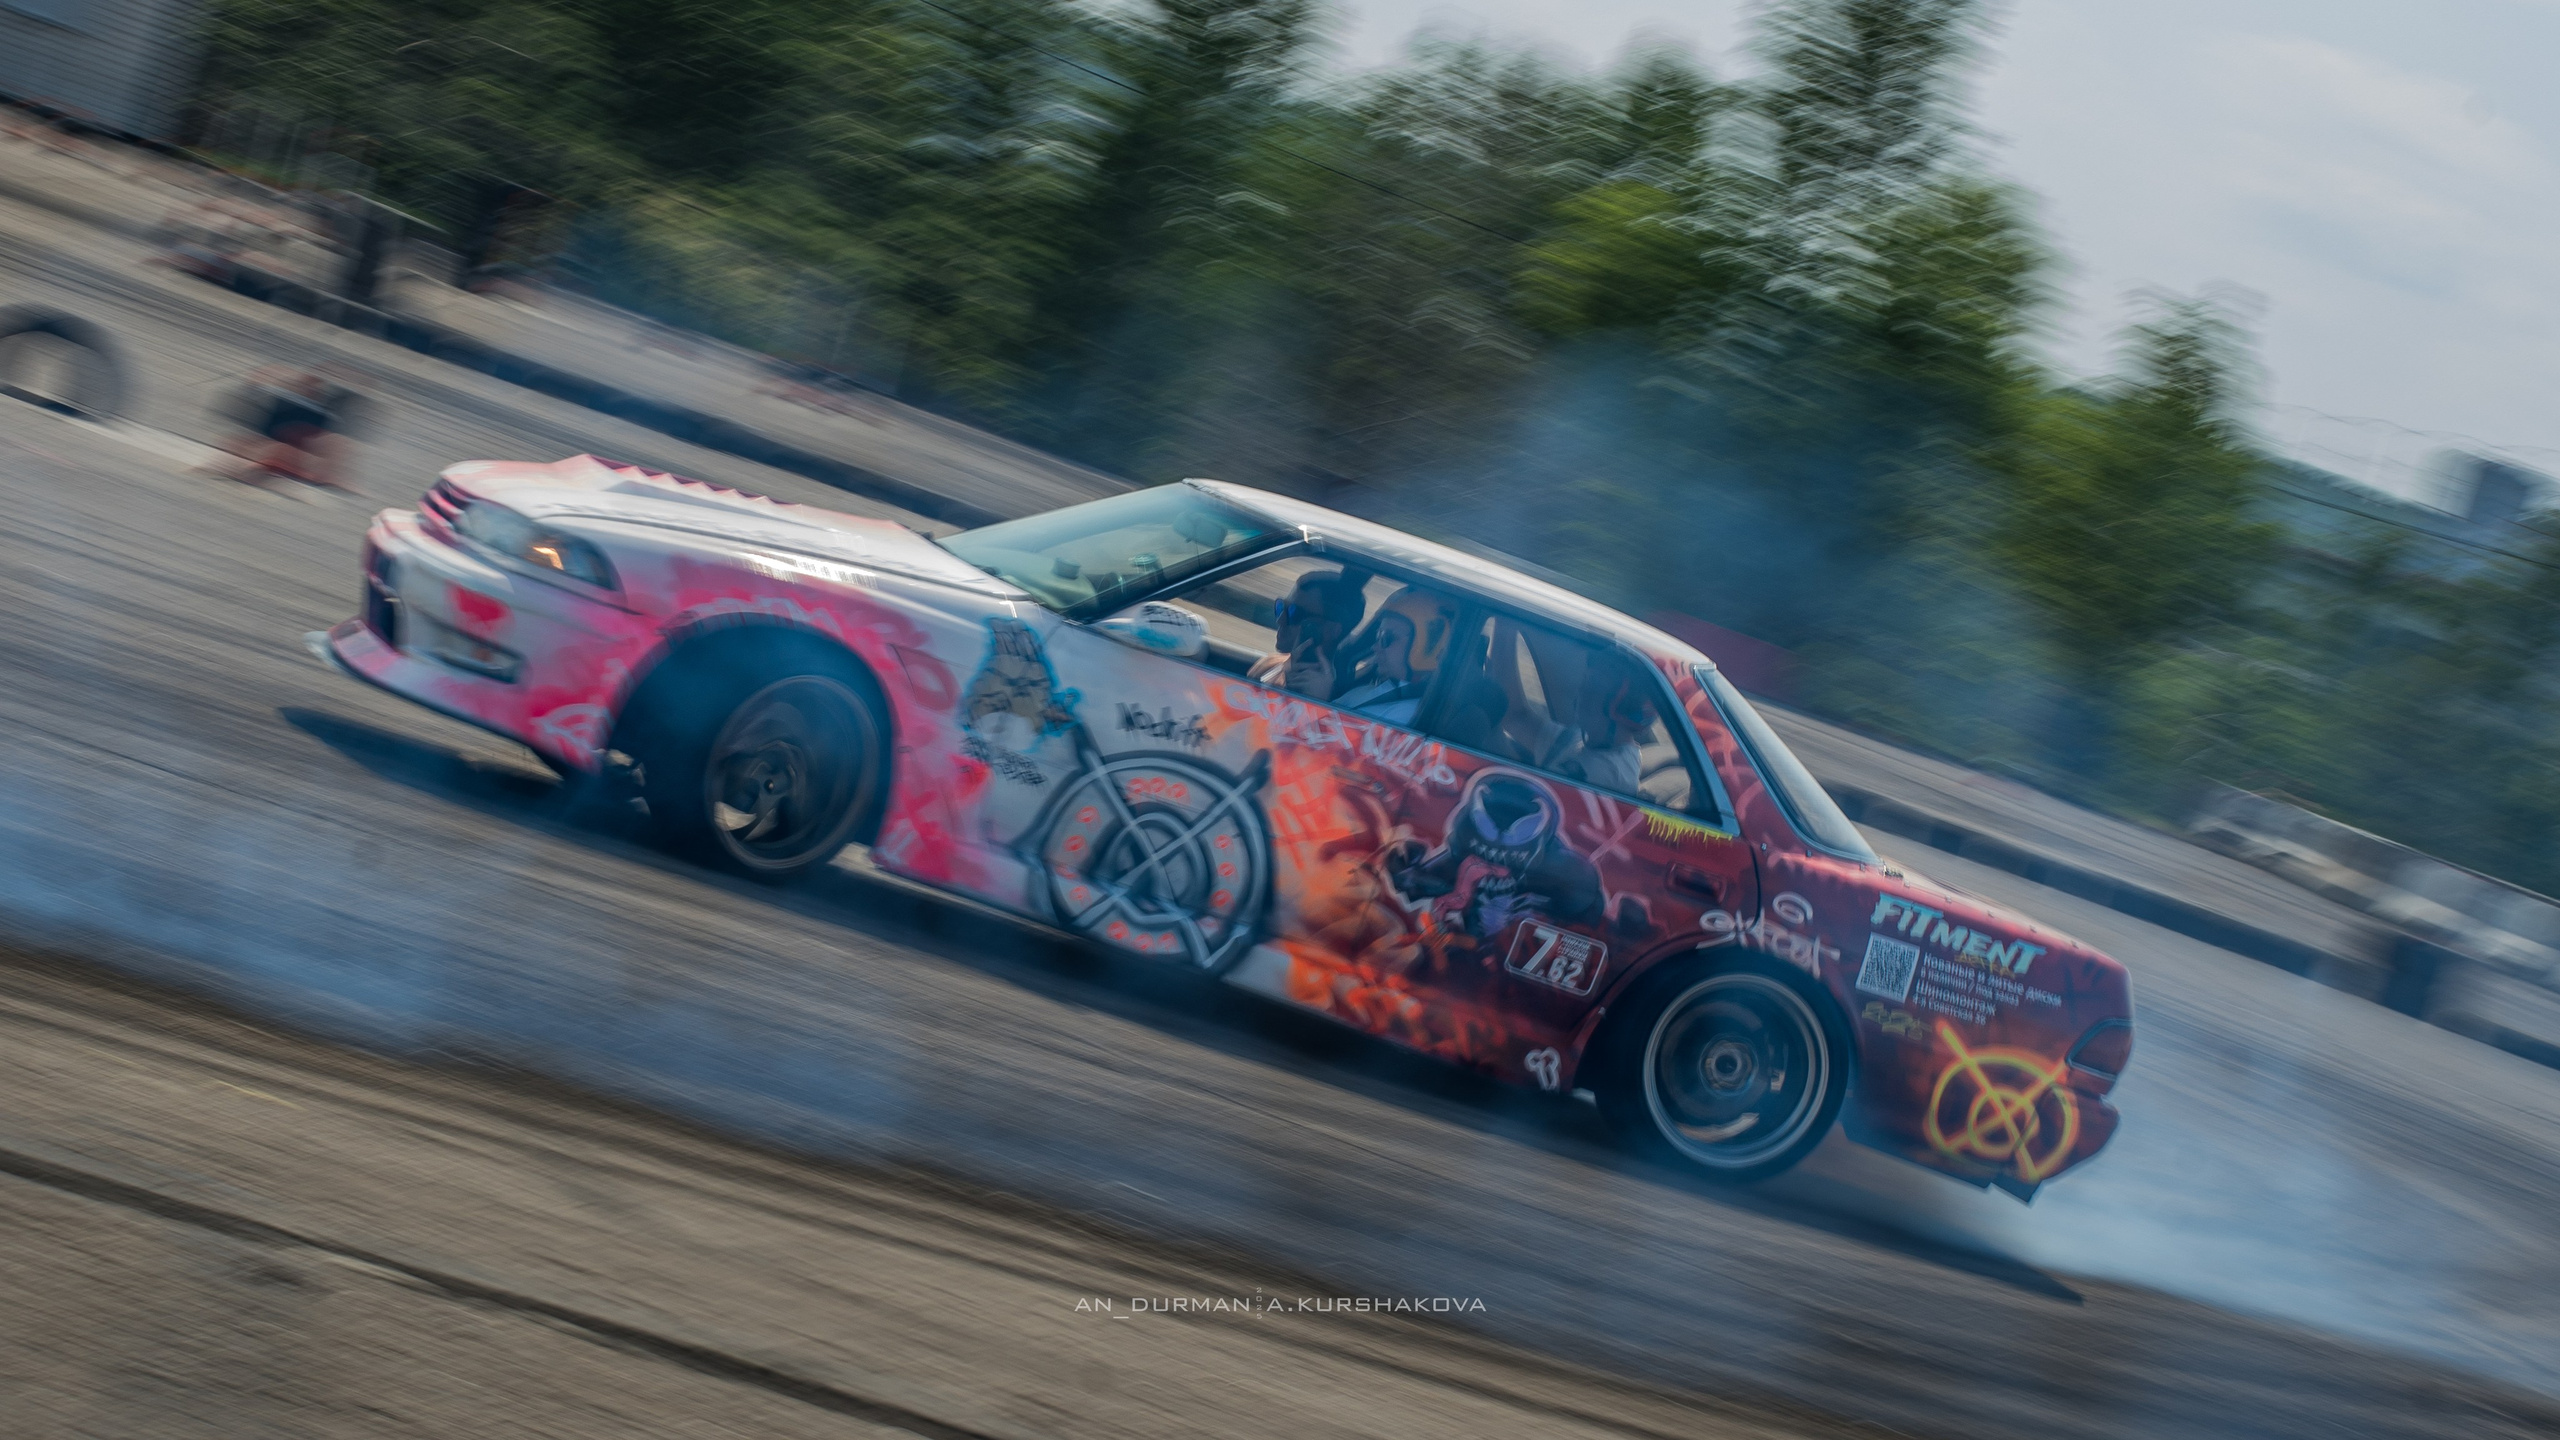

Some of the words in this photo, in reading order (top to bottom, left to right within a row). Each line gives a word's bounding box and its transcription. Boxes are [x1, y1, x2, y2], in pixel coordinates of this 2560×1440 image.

[1915, 980, 1997, 1017] Шиномонтаж
[1923, 952, 1975, 980] Кованые
[1977, 971, 1986, 983] и
[1988, 973, 2025, 996] литые
[2025, 986, 2062, 1008] диски
